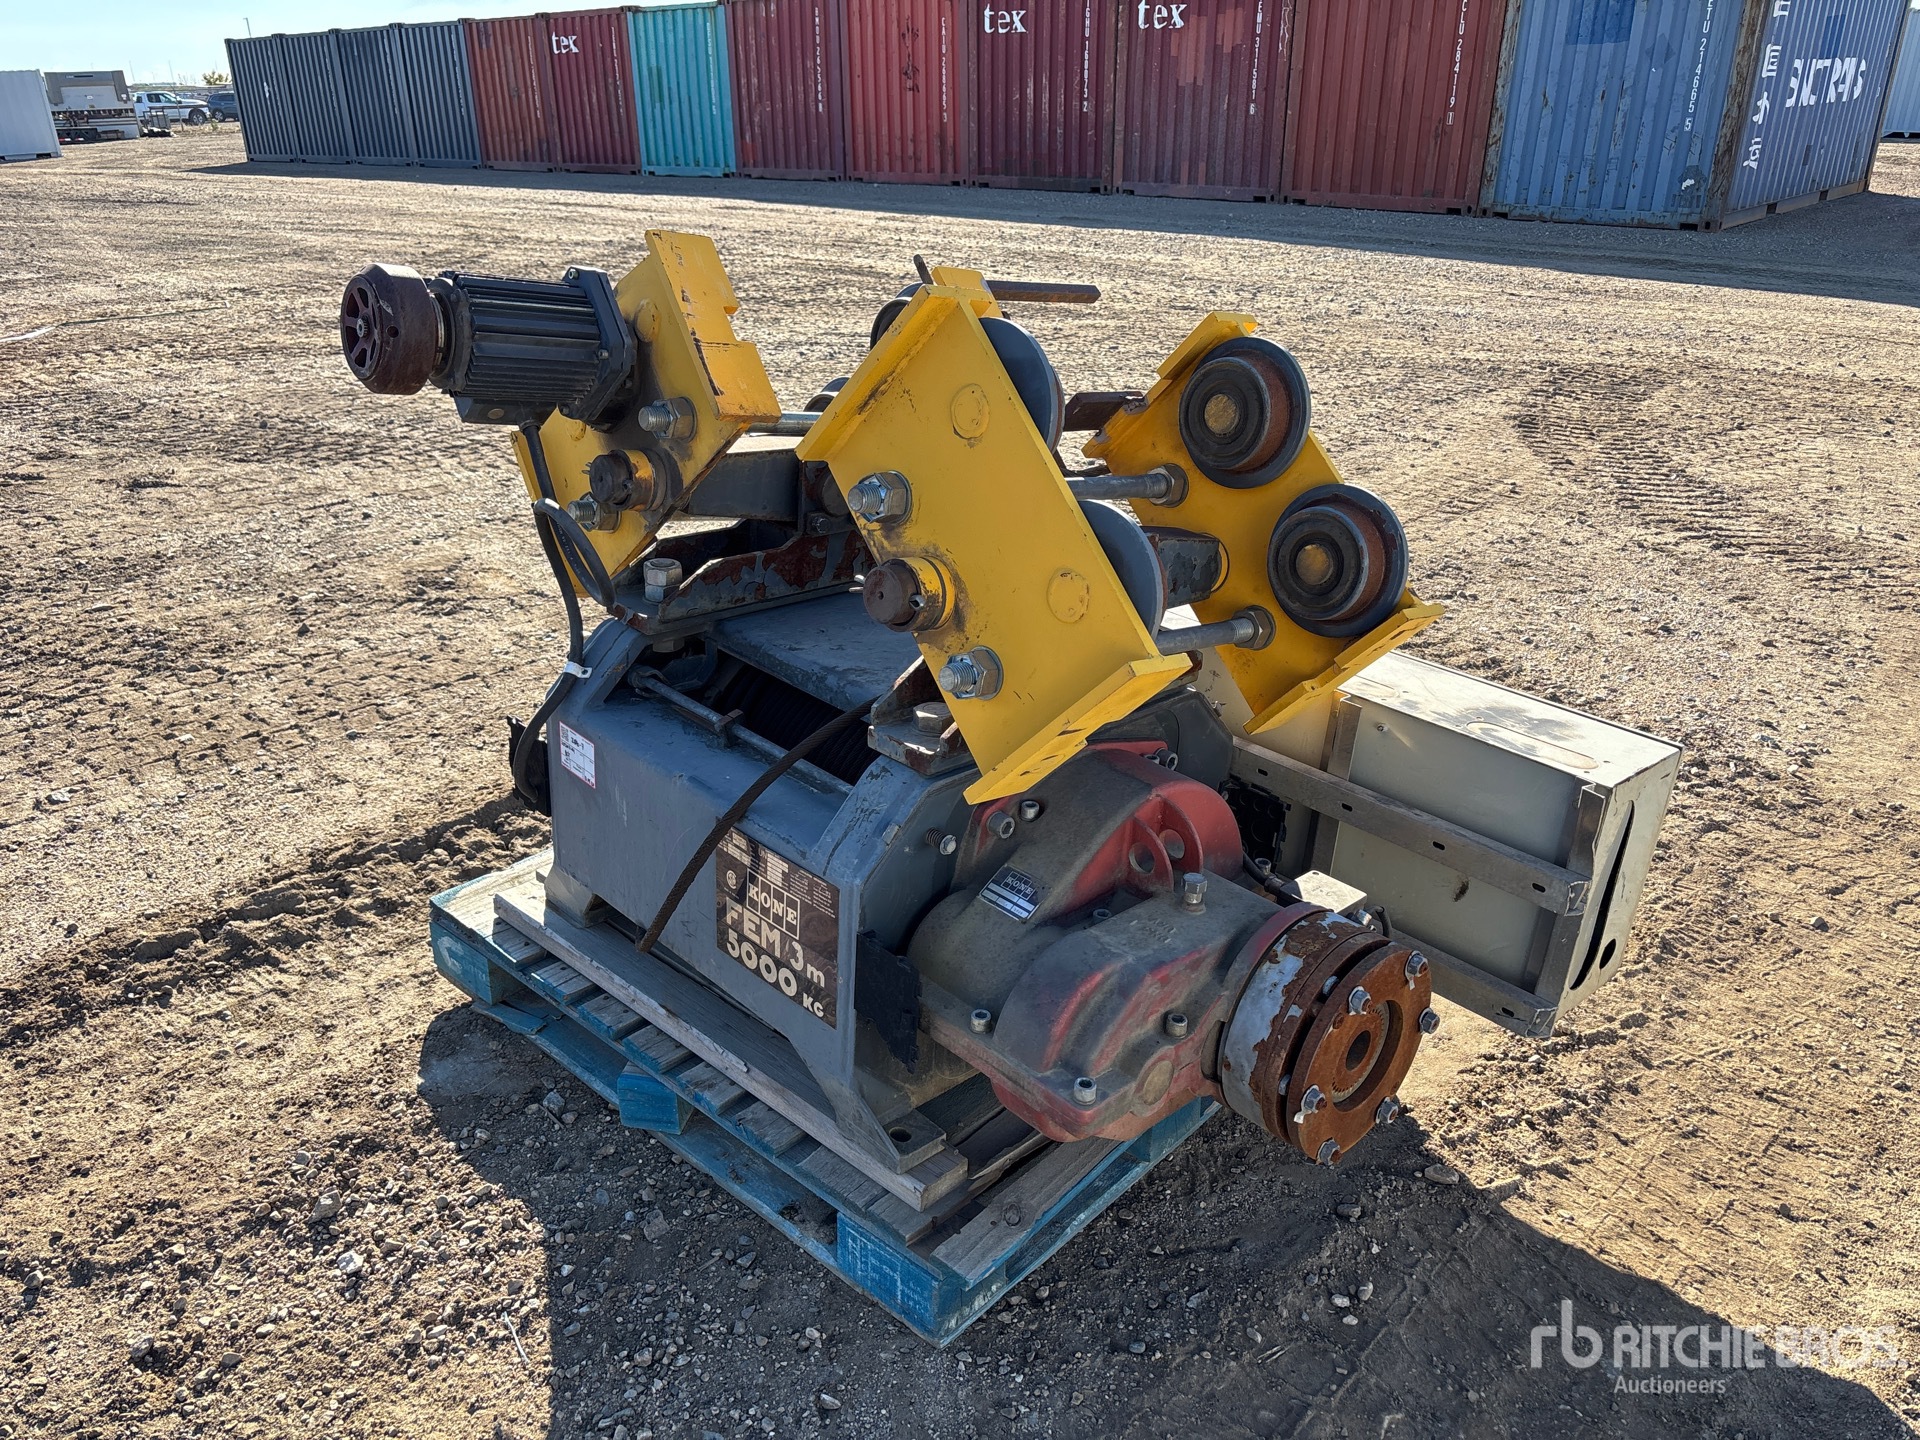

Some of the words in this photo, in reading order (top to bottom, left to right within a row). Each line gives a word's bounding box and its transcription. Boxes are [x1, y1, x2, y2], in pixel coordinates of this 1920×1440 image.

[983, 3, 1027, 33] tex
[1137, 0, 1188, 29] tex
[551, 31, 580, 54] tex
[1251, 37, 1260, 100] 311581
[1449, 39, 1463, 108] 284119
[1688, 38, 1708, 113] 214665
[1785, 57, 1866, 108] SNOTRANS
[1683, 117, 1693, 131] 5
[748, 883, 797, 926] KONE
[1006, 876, 1034, 895] KONE
[726, 896, 781, 958] FEM
[726, 928, 798, 997] 5000
